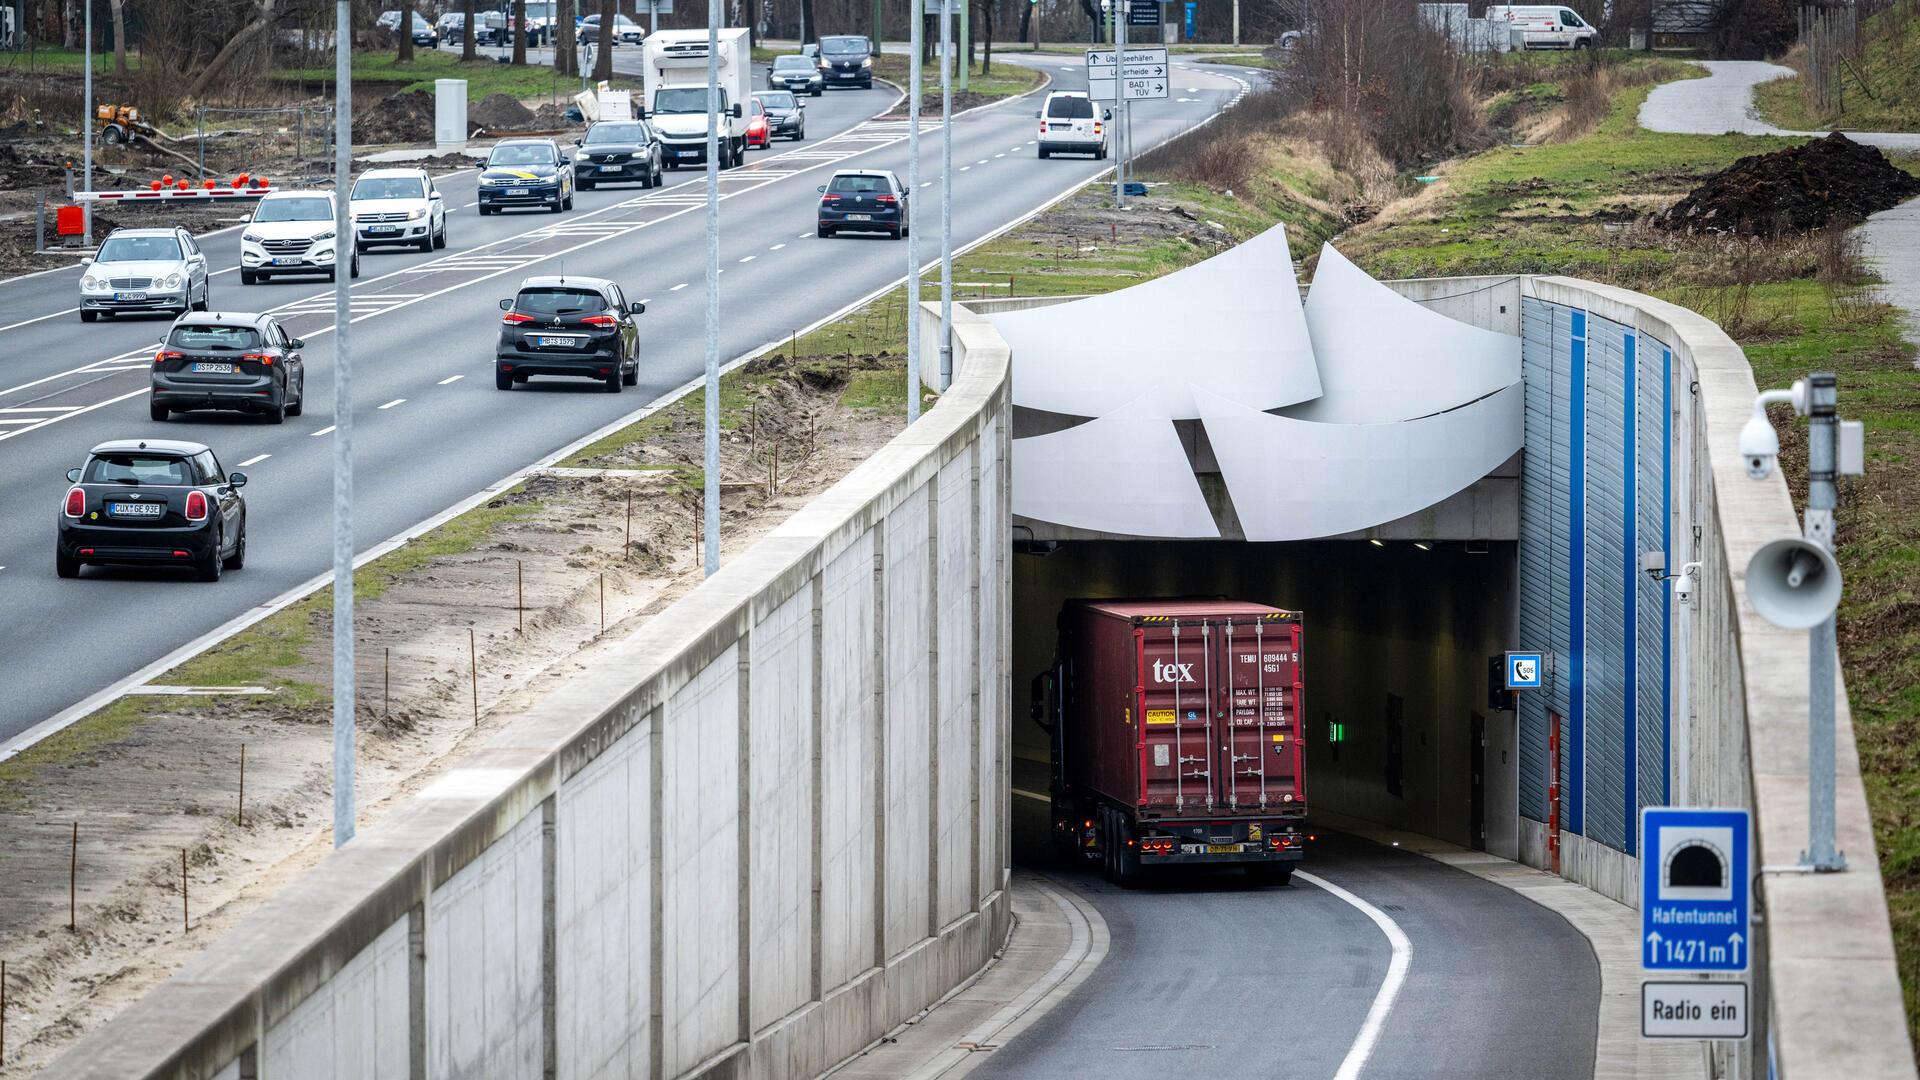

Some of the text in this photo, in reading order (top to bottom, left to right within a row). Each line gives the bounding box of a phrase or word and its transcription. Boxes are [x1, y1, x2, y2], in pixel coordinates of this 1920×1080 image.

[1105, 54, 1153, 62] Übseehäfen
[1135, 88, 1150, 96] TÜV
[197, 363, 206, 371] OS
[214, 363, 231, 371] 2536
[115, 503, 159, 513] CUX GE 93E
[1240, 653, 1298, 663] TEMU 609444 5
[1152, 658, 1194, 683] tex
[1652, 907, 1738, 924] Hafentunnel
[1653, 1000, 1737, 1020] Radio ein
